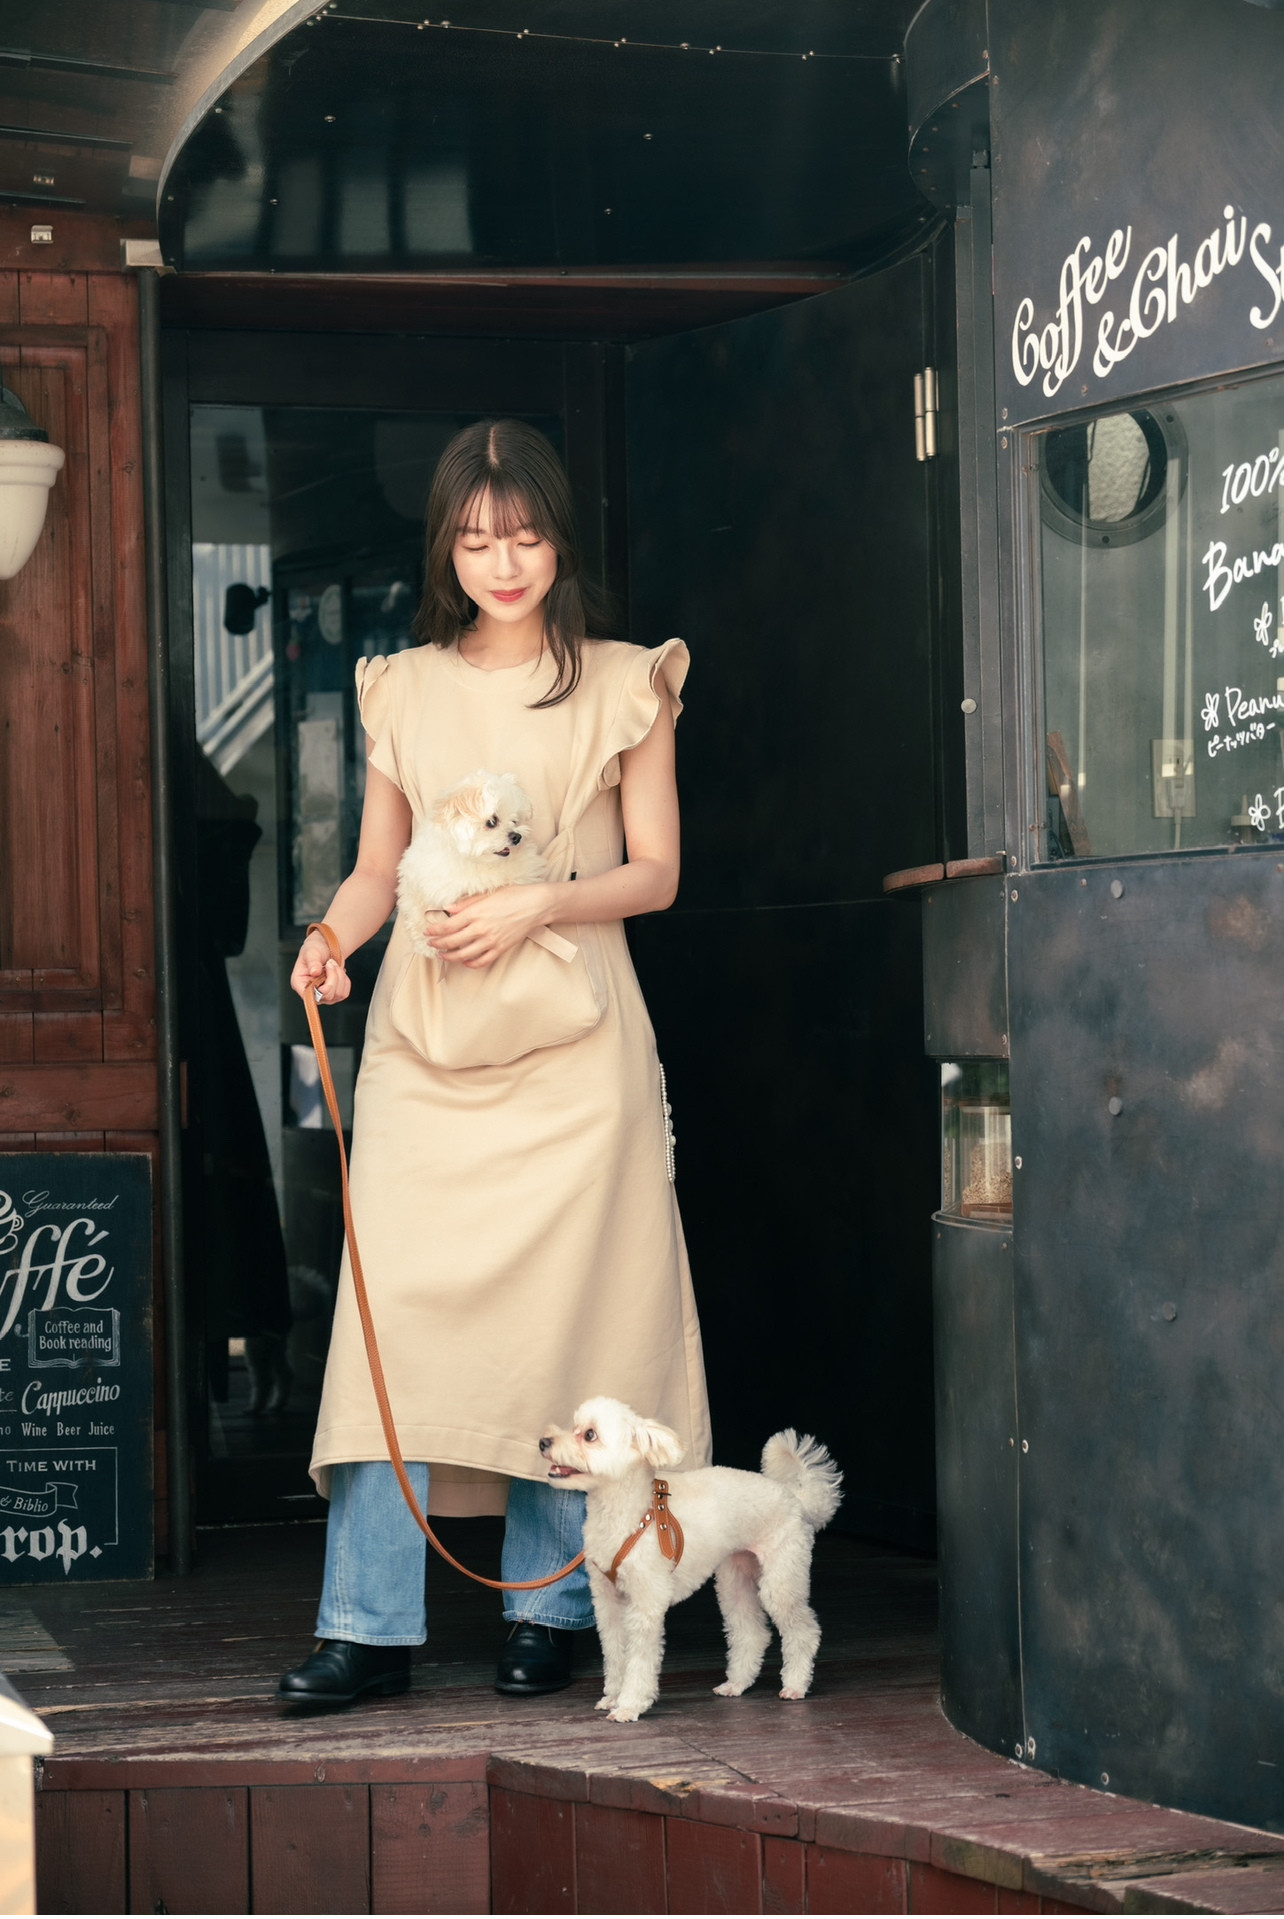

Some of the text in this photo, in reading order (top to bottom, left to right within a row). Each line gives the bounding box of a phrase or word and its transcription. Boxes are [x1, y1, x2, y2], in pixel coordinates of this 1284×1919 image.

[1012, 225, 1132, 397] Coffee
[1207, 722, 1276, 757] ピーナッツバター
[22, 1190, 120, 1218] Guaranteed
[45, 1320, 104, 1334] Coffee and
[39, 1335, 112, 1351] Book reading
[21, 1377, 120, 1416] Cappuccino
[21, 1422, 48, 1437] Wine
[57, 1422, 81, 1436] Beer
[88, 1422, 115, 1436] Juice
[6, 1460, 97, 1472] TIME WITH
[13, 1497, 49, 1512] Biblio
